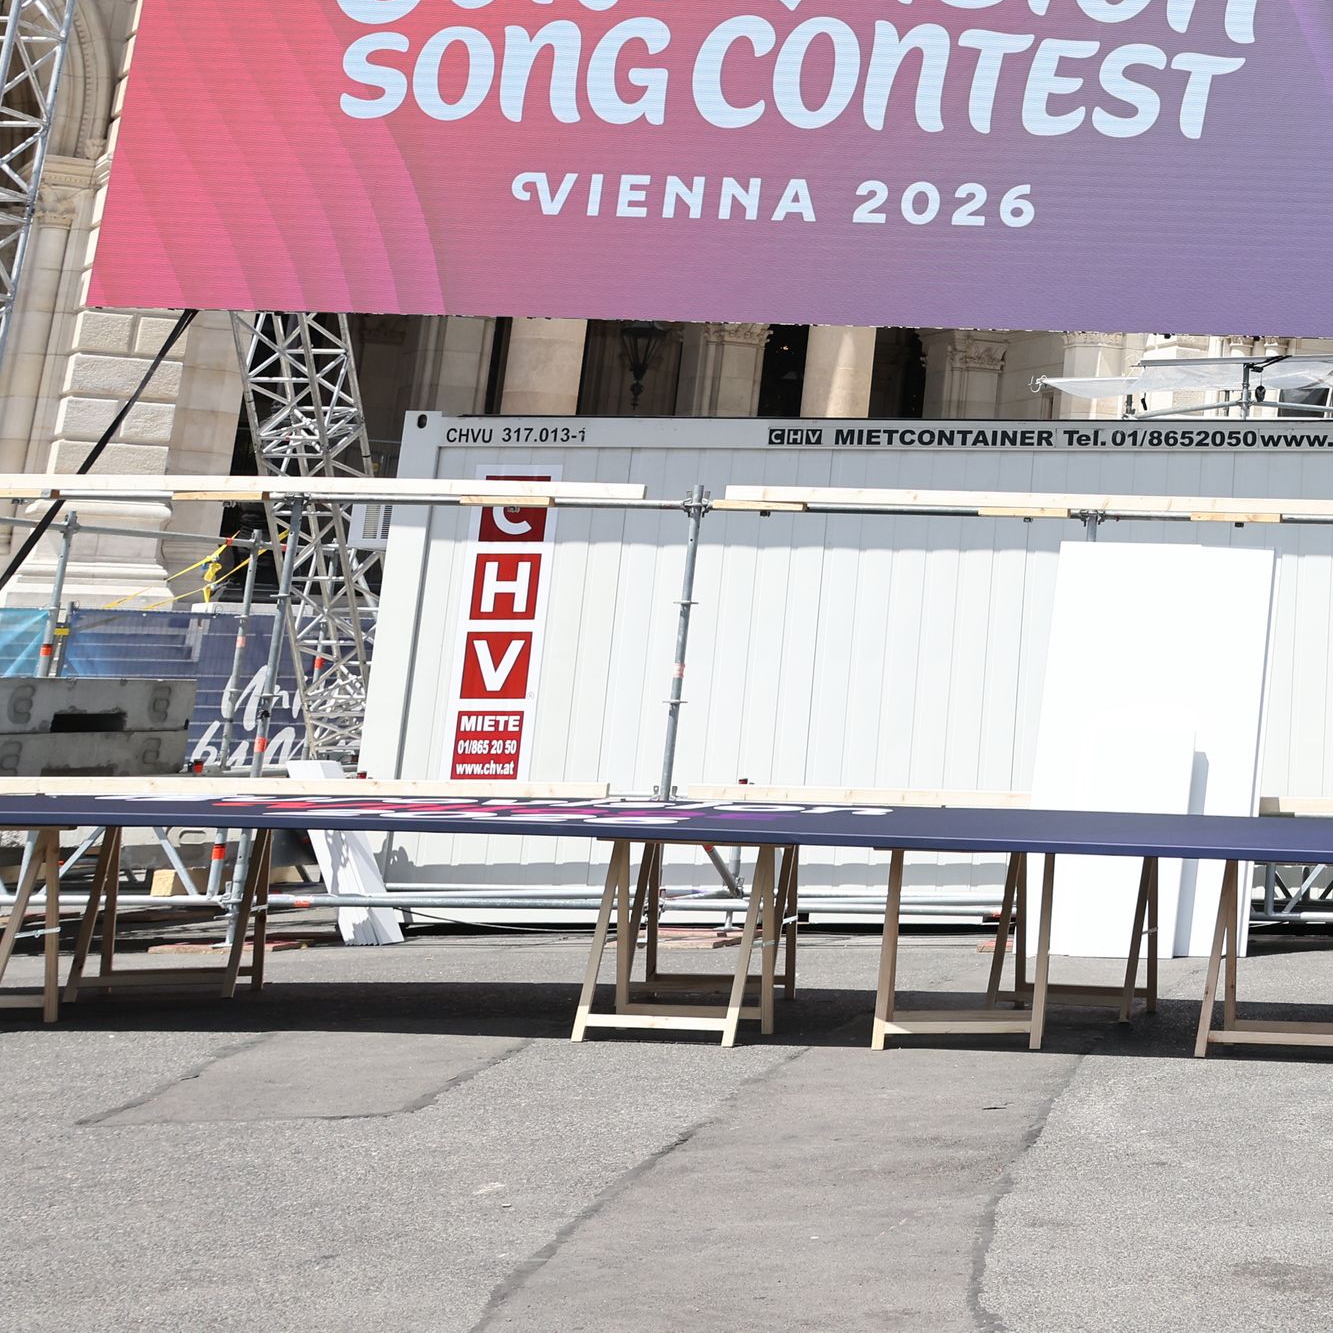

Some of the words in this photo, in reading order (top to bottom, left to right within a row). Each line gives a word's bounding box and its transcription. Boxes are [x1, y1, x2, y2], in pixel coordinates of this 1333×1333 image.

[510, 171, 818, 224] VIENNA
[852, 179, 1036, 229] 2026
[446, 427, 493, 444] CHVU
[501, 427, 587, 443] 317.013-1
[769, 429, 823, 446] CHV
[834, 428, 1053, 447] MIETCONTAINER
[1063, 430, 1106, 447] Tel.
[1111, 430, 1257, 448] 01/8652050
[460, 716, 521, 732] MIETE
[457, 740, 489, 755] 01/865
[491, 740, 504, 755] 20
[505, 740, 517, 755] 50
[456, 761, 515, 776] www.chv.at
[262, 809, 691, 825] 2026
